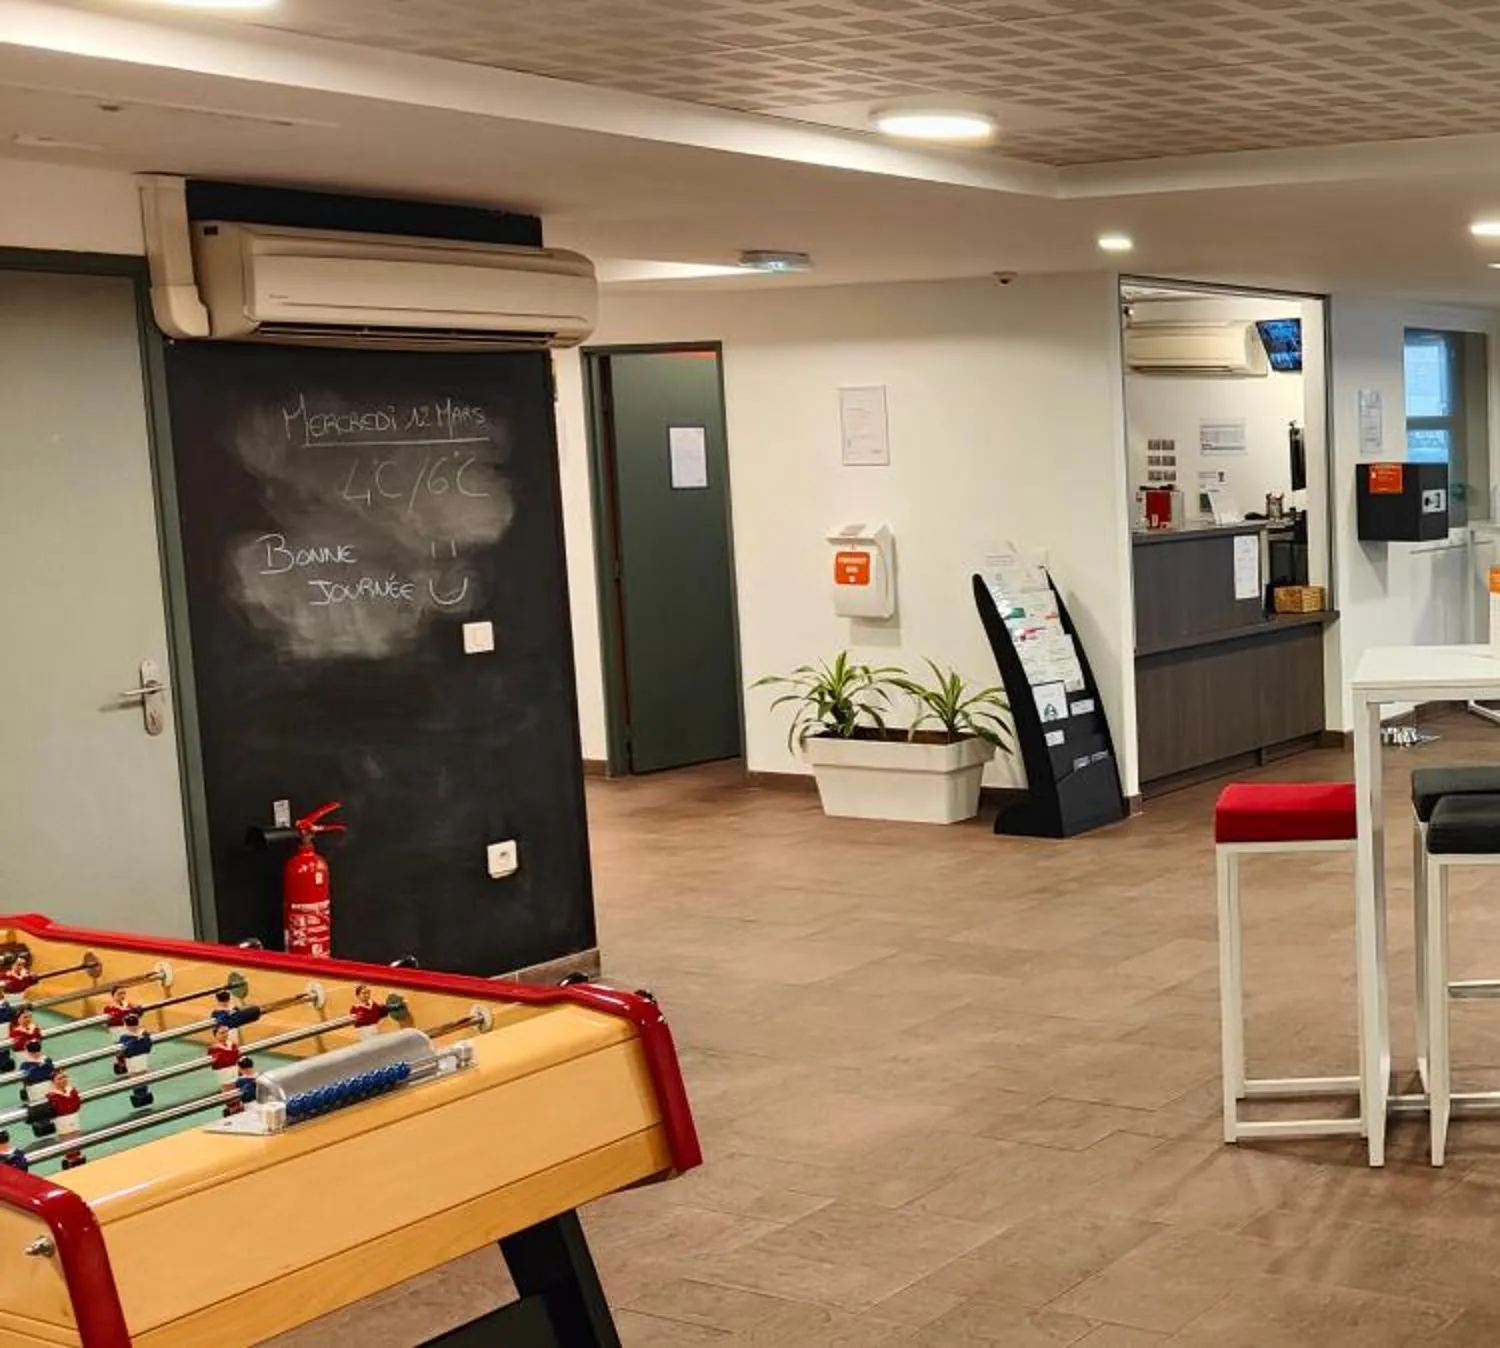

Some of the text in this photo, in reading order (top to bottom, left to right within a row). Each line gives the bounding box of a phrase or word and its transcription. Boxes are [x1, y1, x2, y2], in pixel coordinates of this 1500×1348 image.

[405, 406, 431, 430] 12
[435, 397, 487, 439] MARS
[256, 533, 358, 575] BONNE
